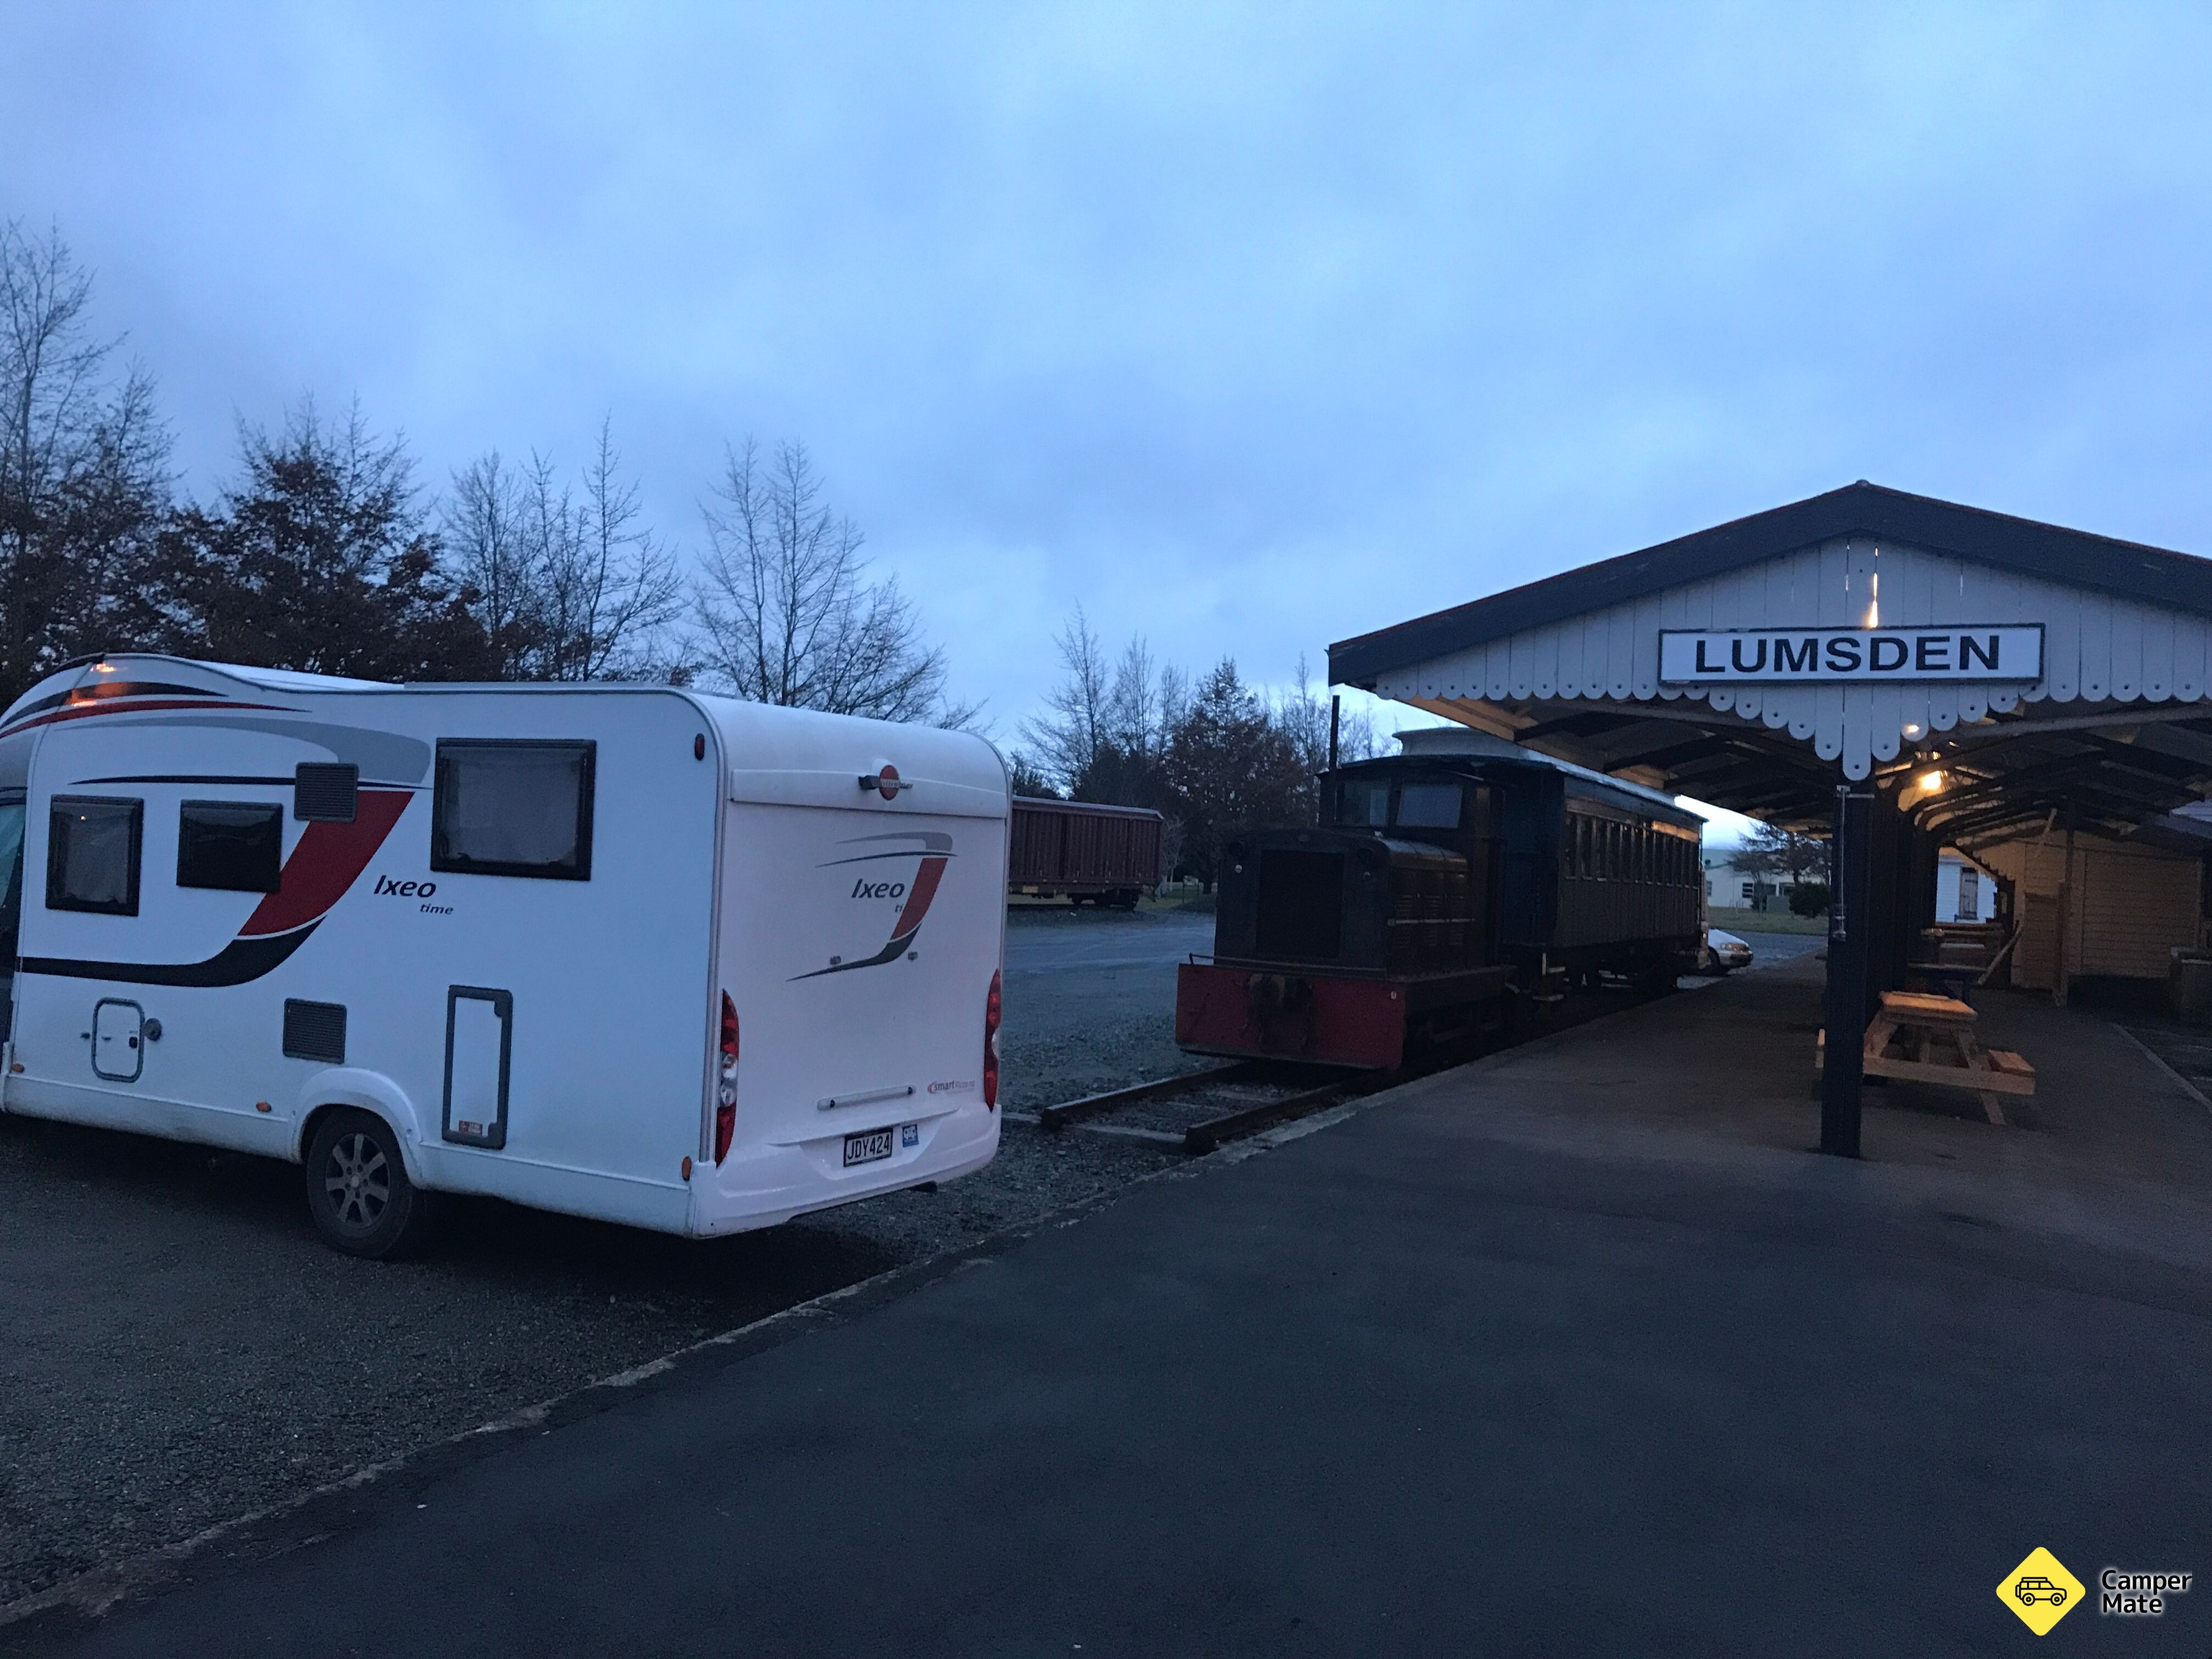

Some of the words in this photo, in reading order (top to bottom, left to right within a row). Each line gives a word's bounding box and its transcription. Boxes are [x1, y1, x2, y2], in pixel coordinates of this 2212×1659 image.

[1695, 635, 2000, 673] LUMSDEN
[374, 875, 437, 898] Ixeo
[851, 878, 905, 899] Ixeo
[420, 904, 453, 914] time
[848, 1133, 890, 1160] JDY424
